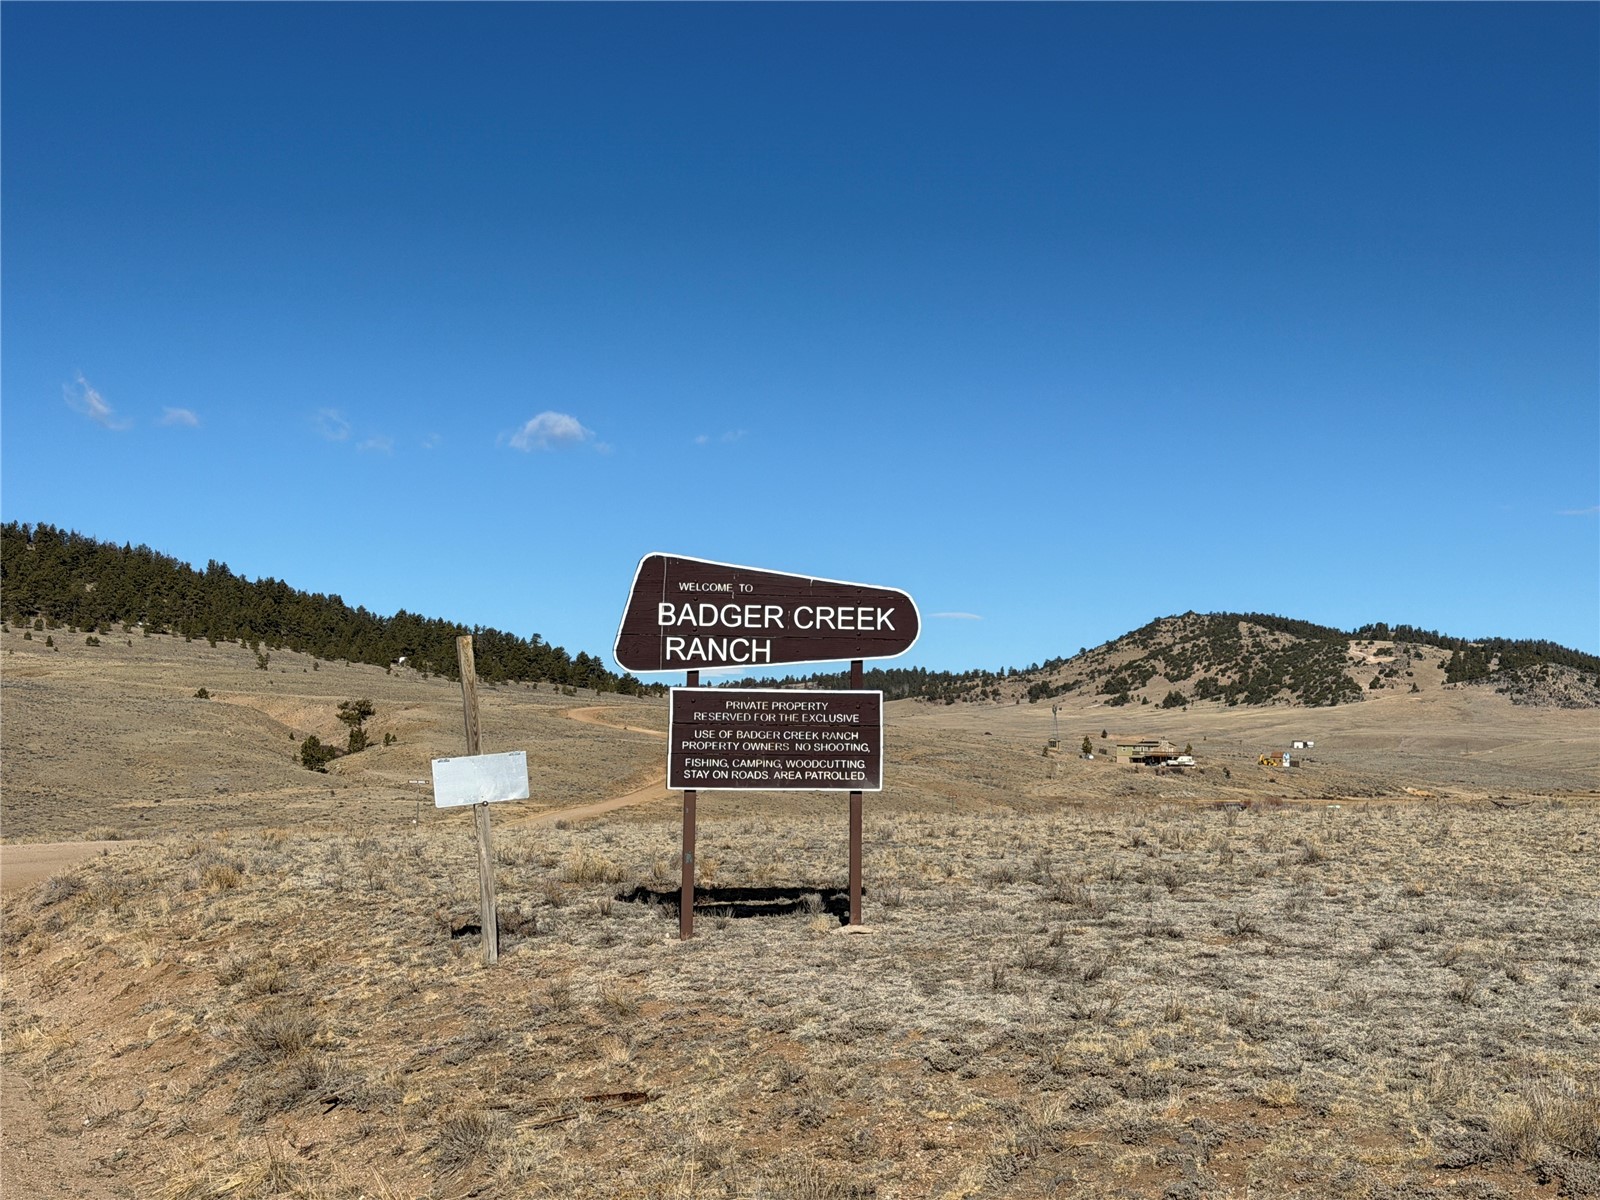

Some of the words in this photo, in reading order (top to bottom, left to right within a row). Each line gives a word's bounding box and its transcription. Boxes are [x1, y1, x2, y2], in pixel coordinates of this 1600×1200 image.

[679, 582, 733, 592] WELCOME
[739, 584, 753, 592] TO
[658, 603, 784, 628] BADGER
[794, 606, 895, 631] CREEK
[666, 637, 771, 662] RANCH
[726, 701, 768, 710] PRIVATE
[772, 702, 828, 710] PROPERTY
[694, 712, 751, 721] RESERVED
[754, 713, 775, 722] FOR
[780, 714, 799, 722] THE
[802, 714, 859, 722] EXCLUSIVE
[695, 730, 715, 738] USE
[719, 730, 733, 739] OF
[737, 731, 780, 740] BADGER
[783, 731, 819, 740] CREEK
[822, 732, 858, 740] RANCH
[682, 742, 739, 751] PROPERTY
[743, 742, 789, 751] OWNERS
[796, 743, 811, 751] NO
[814, 743, 870, 753] SHOOTING,
[685, 758, 729, 768] FISHING,
[732, 759, 783, 769] CAMPING,
[684, 770, 710, 779] STAY
[712, 770, 729, 779] ON
[732, 771, 771, 780] ROADS.
[774, 772, 802, 780] AREA
[805, 772, 867, 780] PATROLLED.
